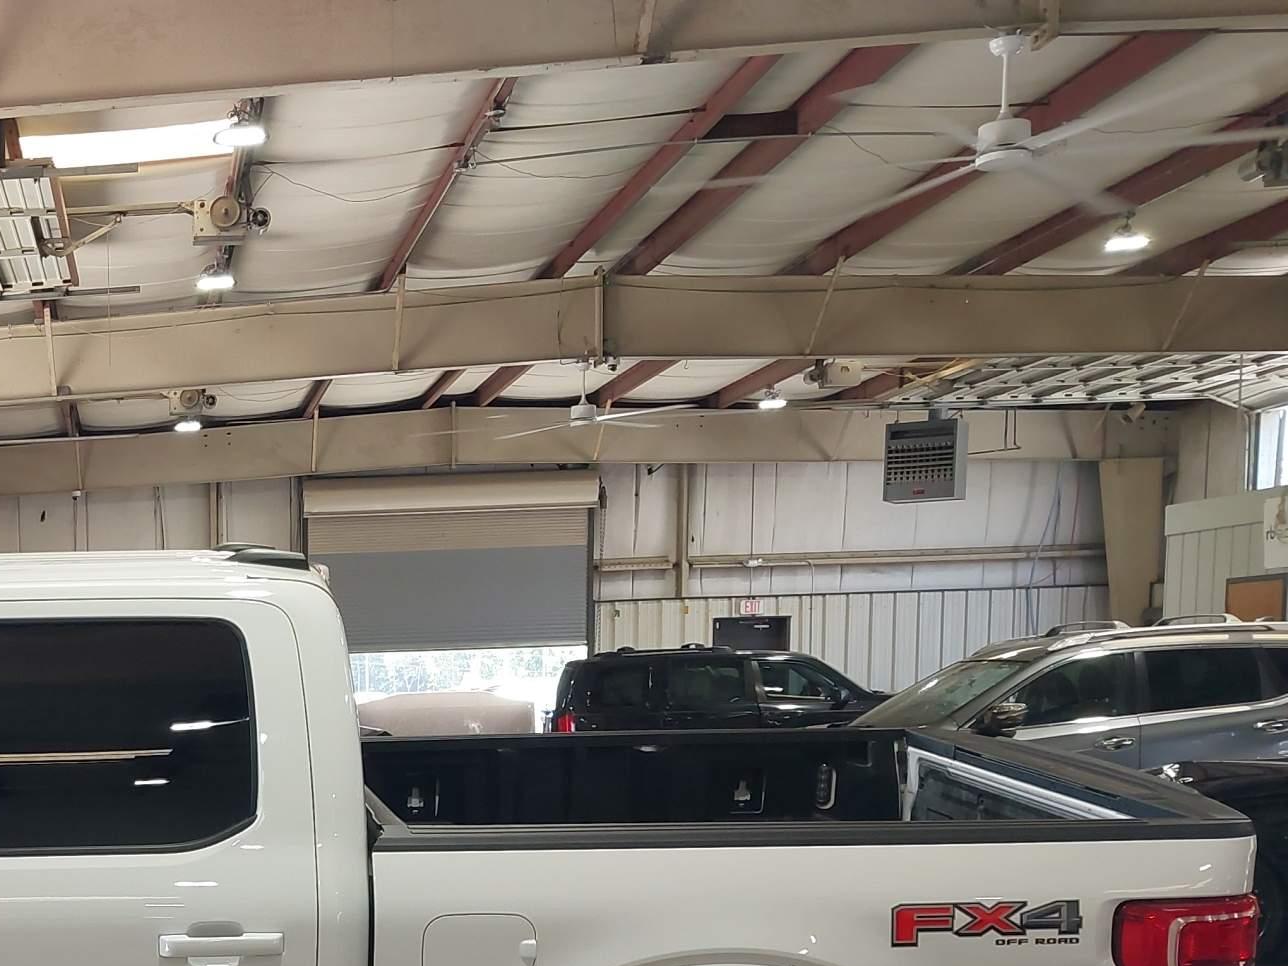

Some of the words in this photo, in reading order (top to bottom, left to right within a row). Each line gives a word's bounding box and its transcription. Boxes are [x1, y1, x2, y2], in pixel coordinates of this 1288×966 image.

[744, 600, 761, 613] EXIT
[891, 899, 1083, 948] FX4
[995, 938, 1029, 946] OFF
[1035, 937, 1080, 945] ROAD
